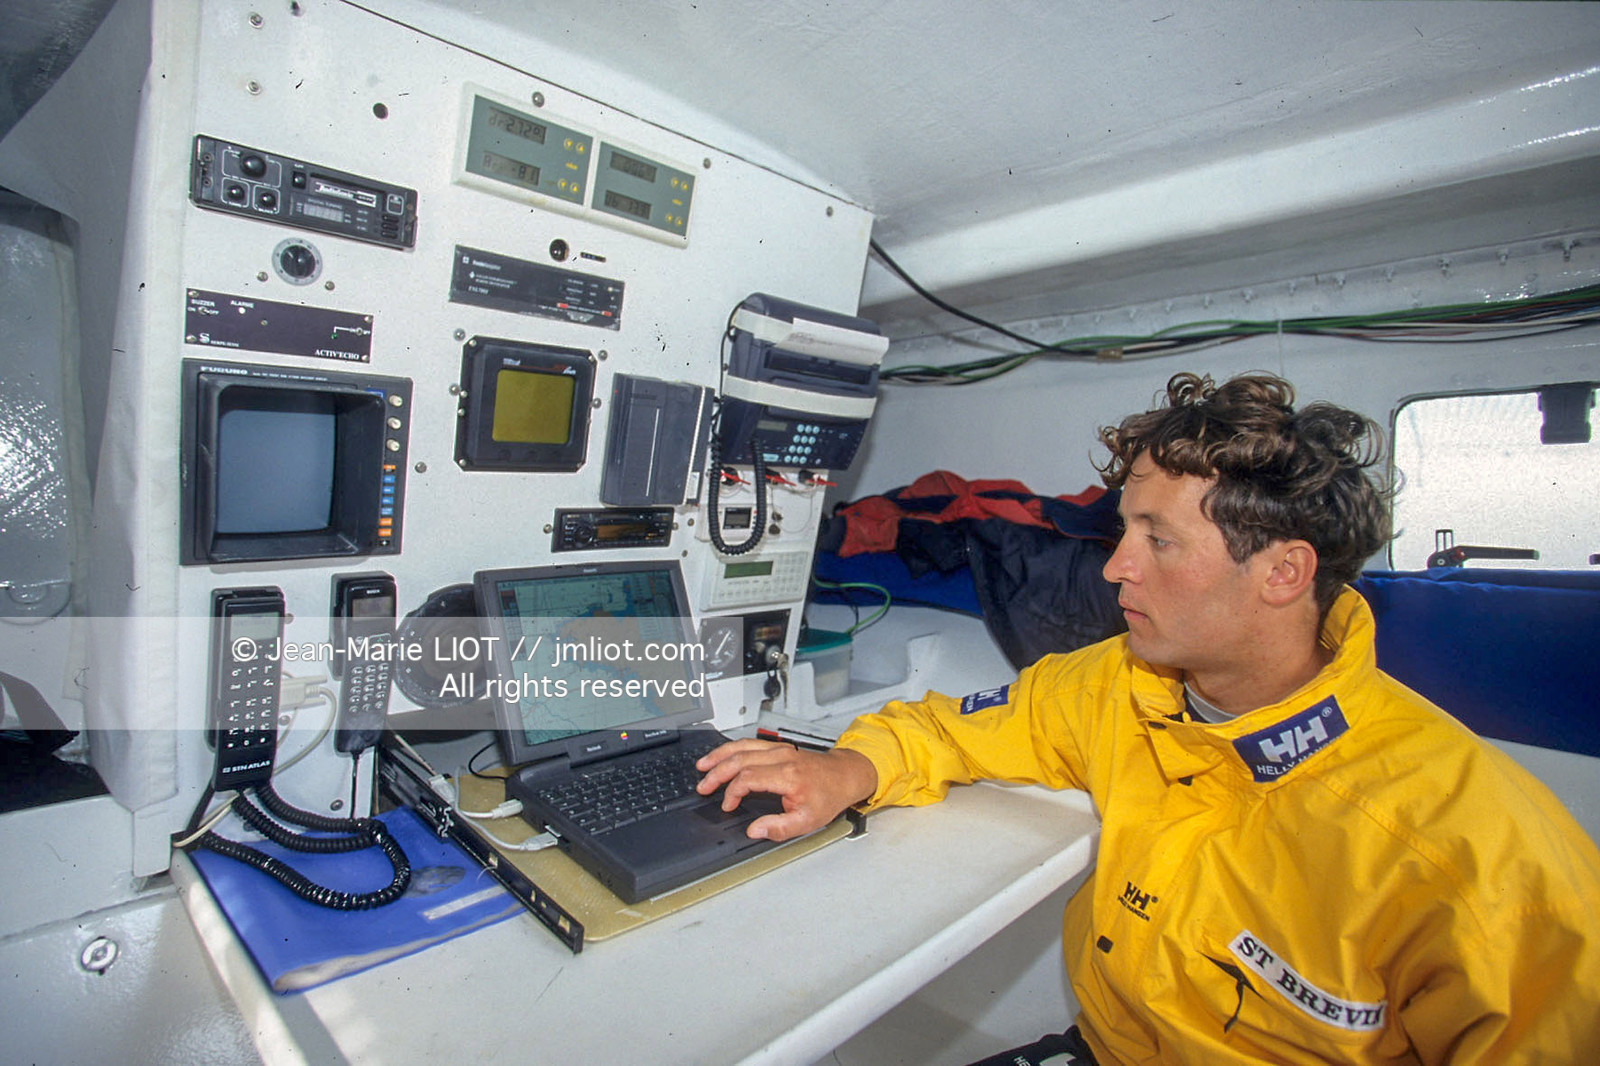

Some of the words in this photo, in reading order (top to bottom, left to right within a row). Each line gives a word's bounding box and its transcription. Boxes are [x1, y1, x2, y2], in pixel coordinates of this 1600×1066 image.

[191, 299, 215, 308] BUZZER
[200, 366, 248, 375] FURUNO
[232, 764, 248, 772] STN
[247, 760, 271, 769] ATLAS
[1238, 936, 1273, 969] ST
